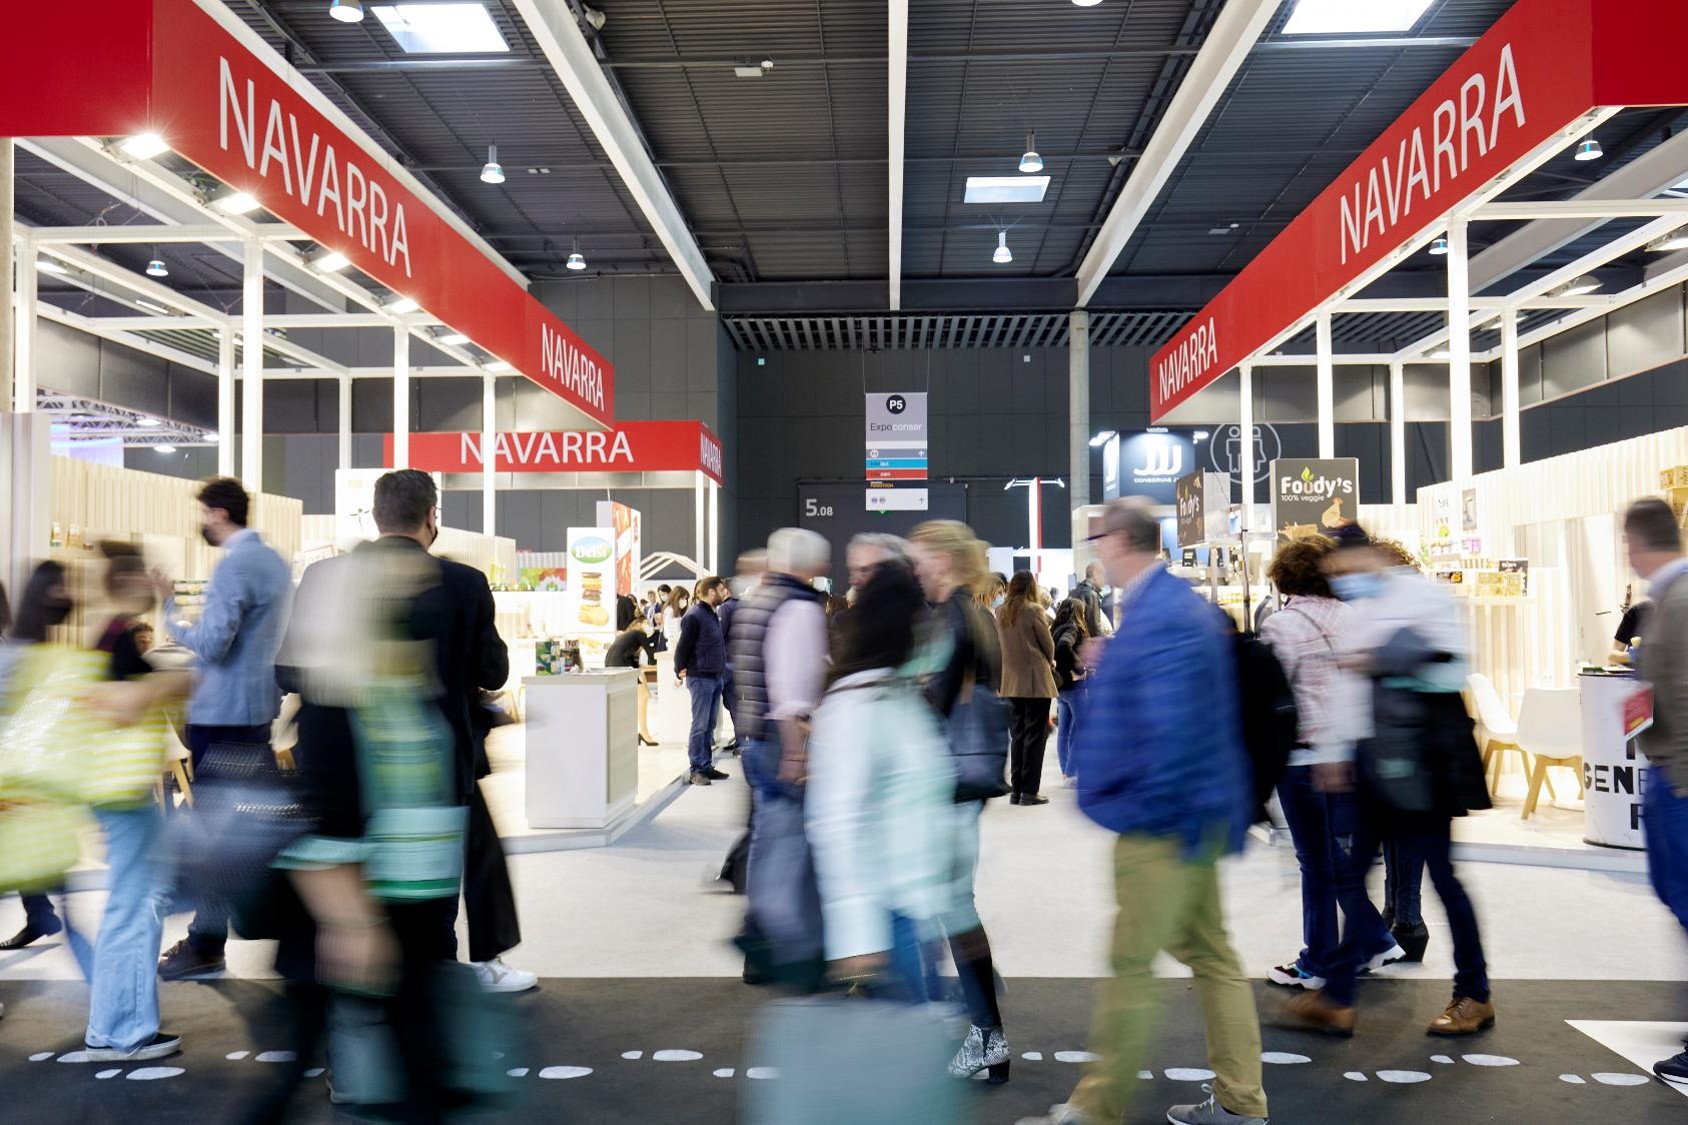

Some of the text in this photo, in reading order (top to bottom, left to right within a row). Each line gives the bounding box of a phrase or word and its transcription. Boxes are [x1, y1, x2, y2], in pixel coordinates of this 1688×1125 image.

[219, 56, 412, 278] NAVARRA
[1340, 43, 1526, 265] NAVARRA
[541, 322, 605, 412] NAVARRA
[1158, 317, 1218, 405] NAVARRA
[889, 400, 903, 410] P5
[461, 431, 634, 464] NAVARRA
[700, 432, 722, 478] NAVARRA
[806, 498, 833, 517] 5.08
[1281, 494, 1325, 503] 100% veggie
